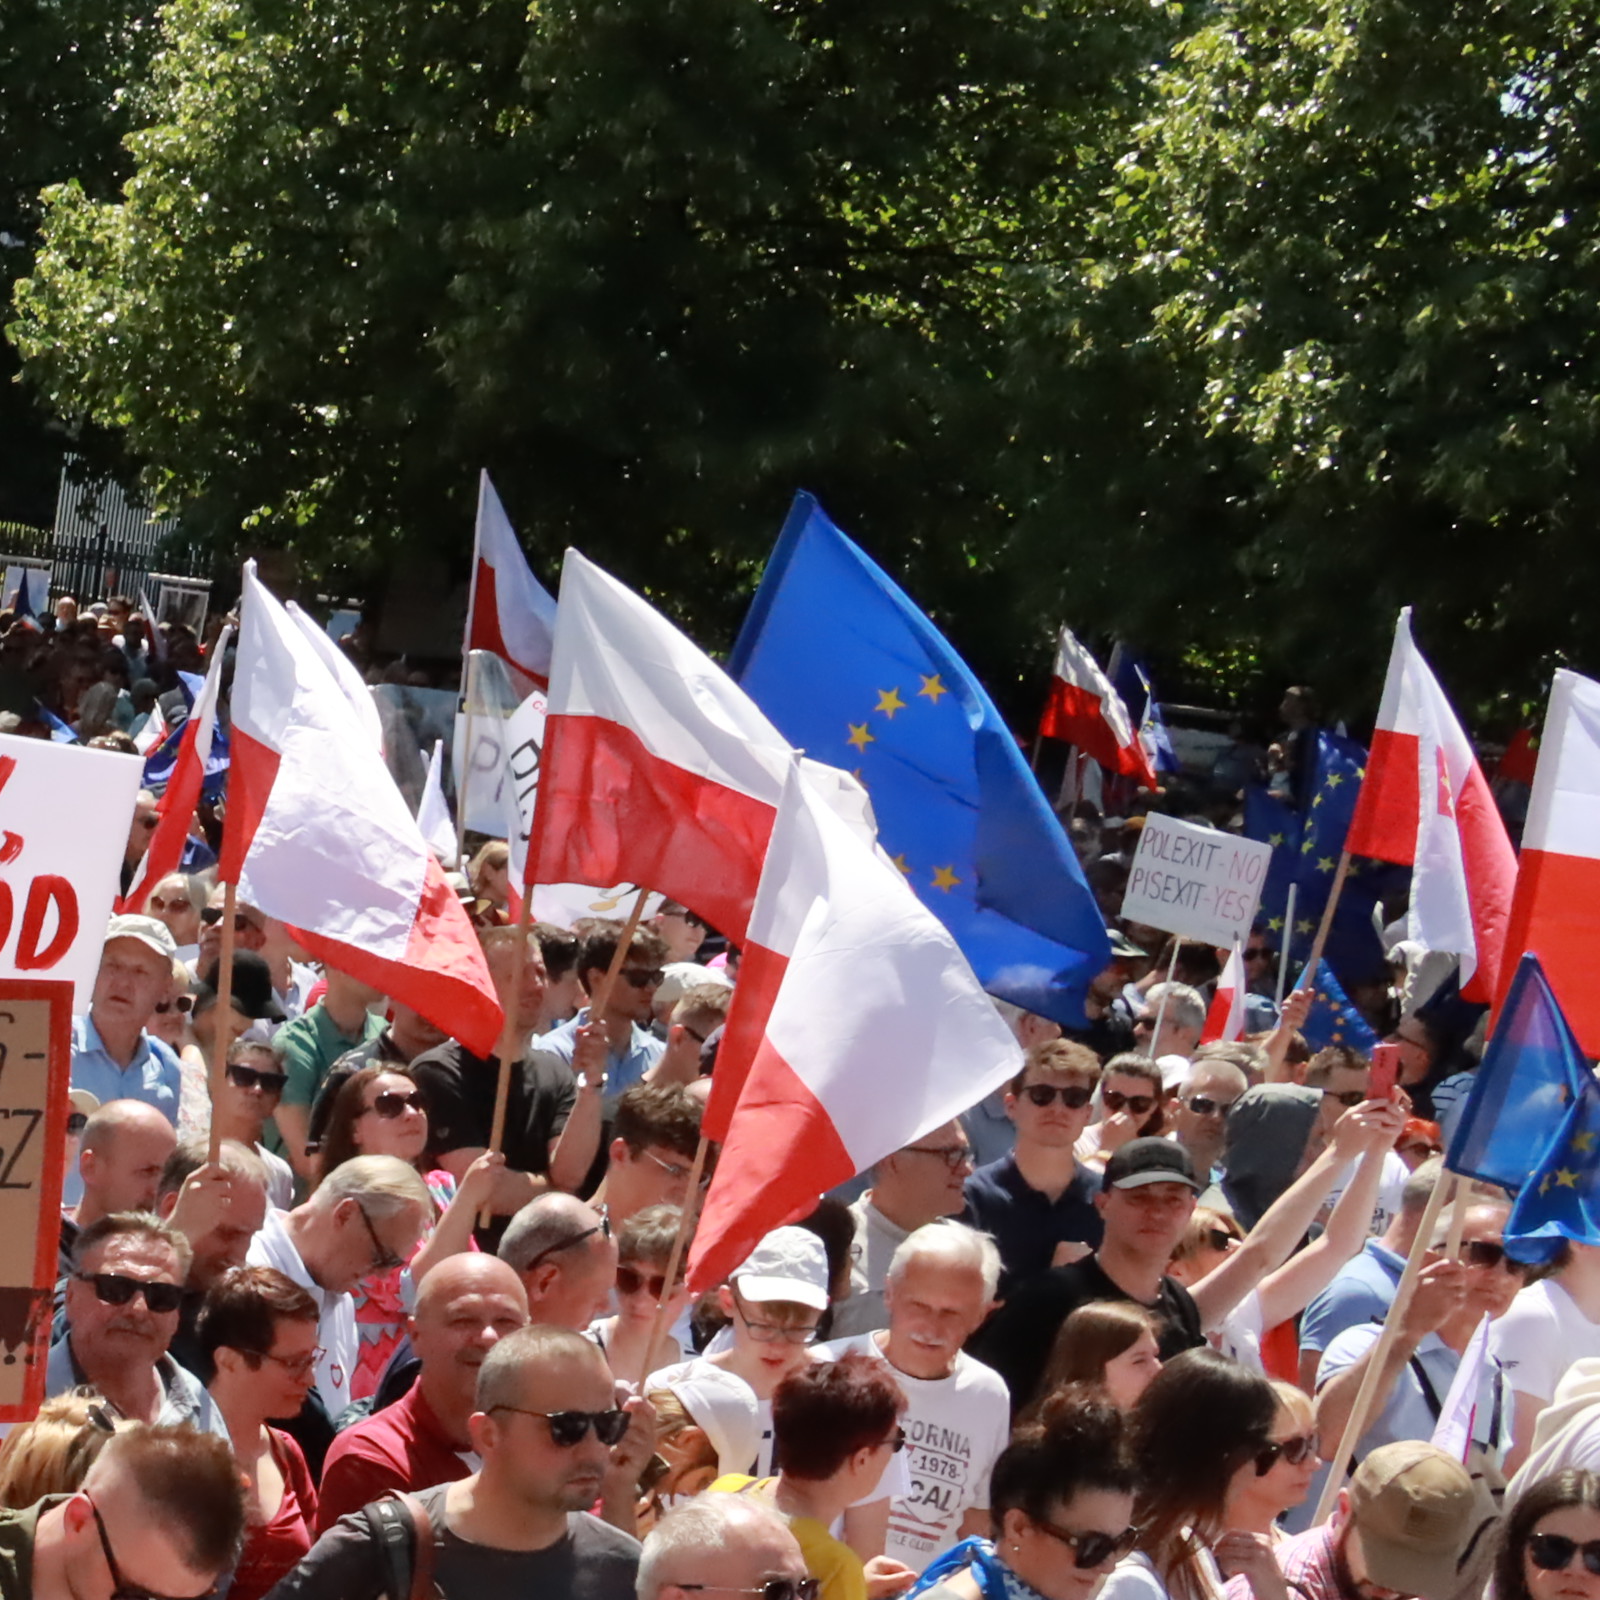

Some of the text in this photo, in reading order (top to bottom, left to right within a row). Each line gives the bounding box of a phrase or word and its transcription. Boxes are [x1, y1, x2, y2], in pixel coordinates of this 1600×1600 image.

[1140, 827, 1221, 871] POLEXIT
[1228, 850, 1262, 885] NO
[1131, 867, 1206, 910] PISEXIT
[1213, 886, 1250, 922] YES
[901, 1417, 972, 1459] ORNIA
